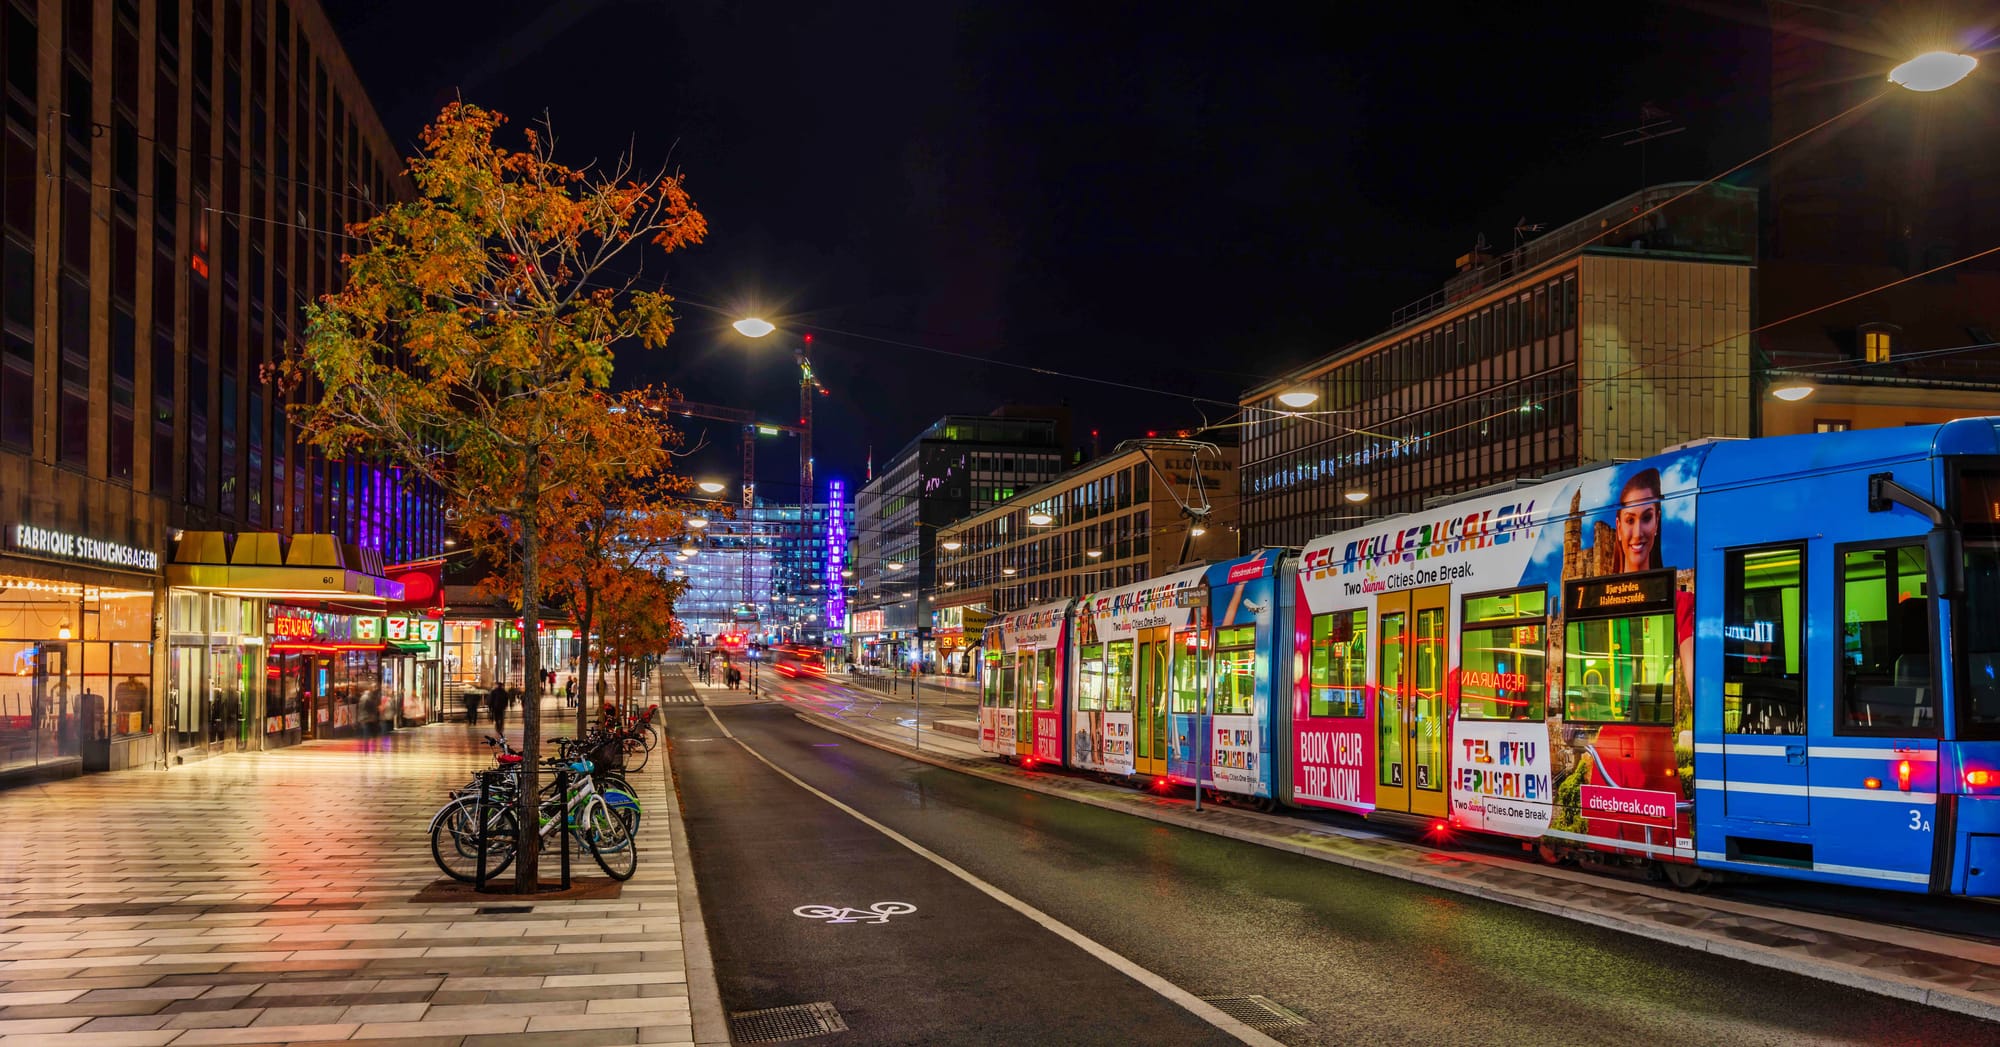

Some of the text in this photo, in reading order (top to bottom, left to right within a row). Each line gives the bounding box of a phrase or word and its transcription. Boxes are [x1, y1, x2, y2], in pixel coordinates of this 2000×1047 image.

[17, 523, 159, 570] FABRIQUE STENUGNSBAGERI
[1304, 547, 1337, 582] TEL
[1344, 582, 1361, 596] Two
[1440, 561, 1474, 581] Break.
[1577, 586, 1585, 609] 7
[1218, 729, 1233, 747] TEL
[1300, 731, 1363, 767] BOOK YOUR
[1463, 739, 1492, 763] TEL
[1303, 765, 1360, 803] TRIP NOW!
[1454, 799, 1467, 810] Two
[1525, 808, 1548, 821] Break.
[1589, 795, 1666, 817] citiesbreak.com
